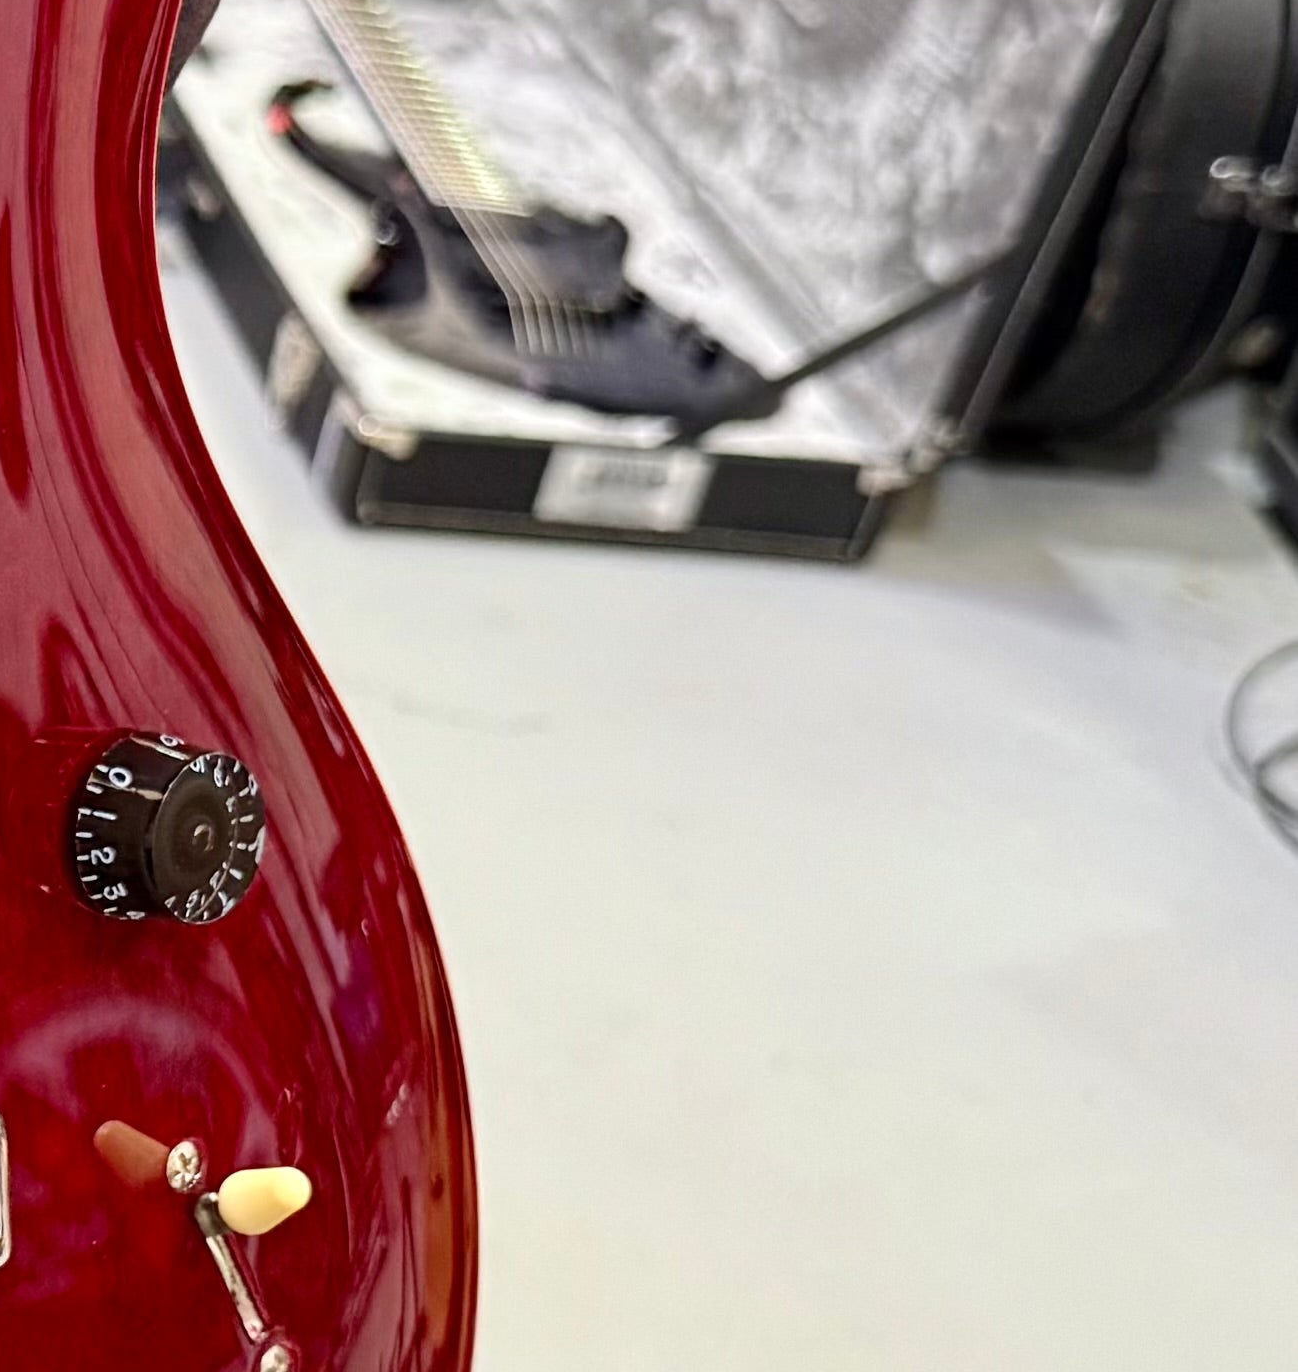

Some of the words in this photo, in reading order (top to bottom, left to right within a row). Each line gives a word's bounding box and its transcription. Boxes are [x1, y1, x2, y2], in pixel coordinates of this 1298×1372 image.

[108, 766, 133, 789] 0
[91, 846, 117, 866] 2
[103, 882, 129, 901] 3
